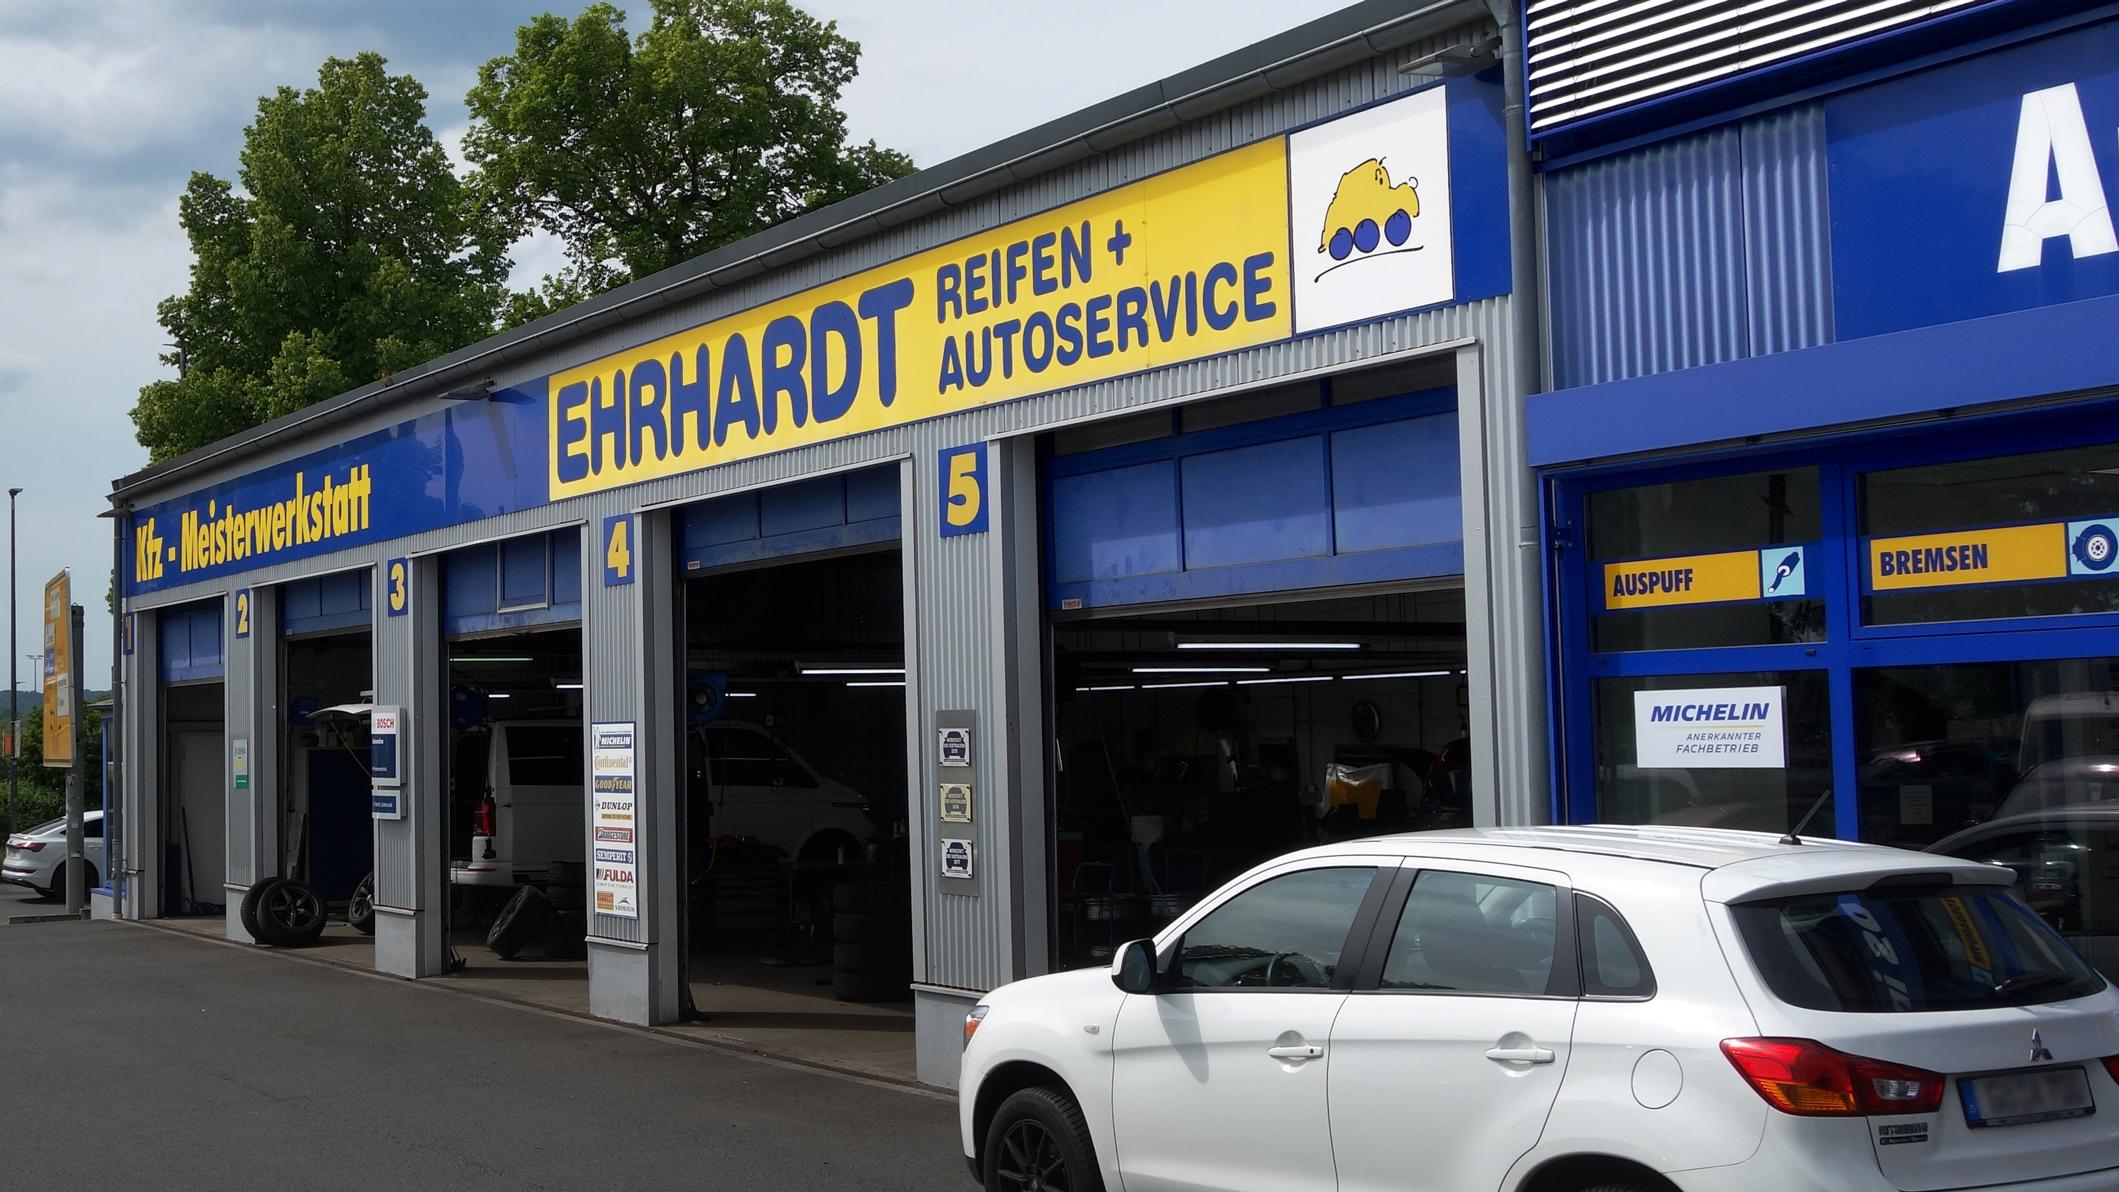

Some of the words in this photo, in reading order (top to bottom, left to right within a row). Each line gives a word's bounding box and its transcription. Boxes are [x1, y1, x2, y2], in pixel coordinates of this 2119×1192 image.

[937, 220, 1092, 324] REIFEN
[1107, 219, 1132, 266] +
[938, 251, 1277, 395] AUTOSERVICE
[557, 277, 914, 483] EHRHARDT
[947, 452, 980, 526] 5
[136, 517, 163, 583] Kfz
[181, 464, 371, 573] Meisterwerkstatt
[608, 521, 629, 577] 4
[1880, 543, 1988, 577] BREMSEN
[391, 563, 405, 610] 3
[1612, 568, 1693, 598] AUSPUFF
[238, 594, 248, 634] 2
[376, 718, 395, 728] BOSCH
[1650, 702, 1770, 722] MICHELIN
[600, 737, 631, 745] MICHELIN
[1676, 743, 1759, 754] FACHBETRIEB
[1686, 732, 1762, 741] ANERKANNTER
[595, 777, 632, 791] GOODYEAR
[601, 801, 632, 811] DUNLOP
[596, 850, 627, 862] SEMPERIT
[603, 868, 634, 883] FULDA
